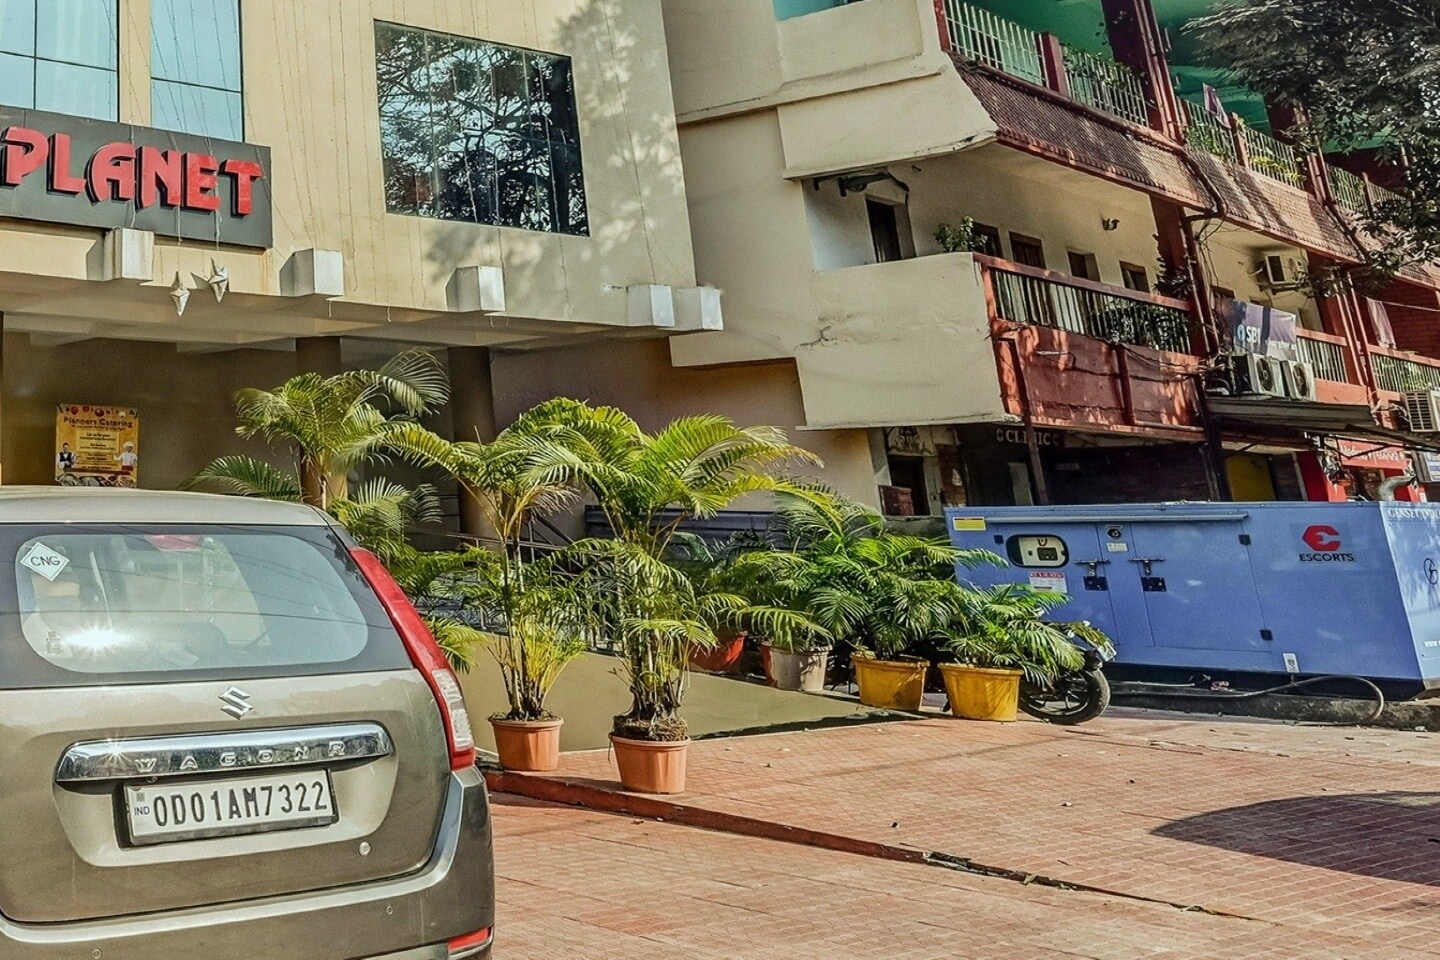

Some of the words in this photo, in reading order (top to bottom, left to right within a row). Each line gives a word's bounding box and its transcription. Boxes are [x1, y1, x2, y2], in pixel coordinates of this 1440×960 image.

[0, 125, 262, 217] PLANET
[1245, 325, 1261, 343] SBI
[63, 416, 98, 426] Planners
[99, 418, 133, 429] Catering
[30, 555, 61, 567] CNG
[1298, 552, 1355, 563] ESCORTS
[133, 805, 151, 816] IND
